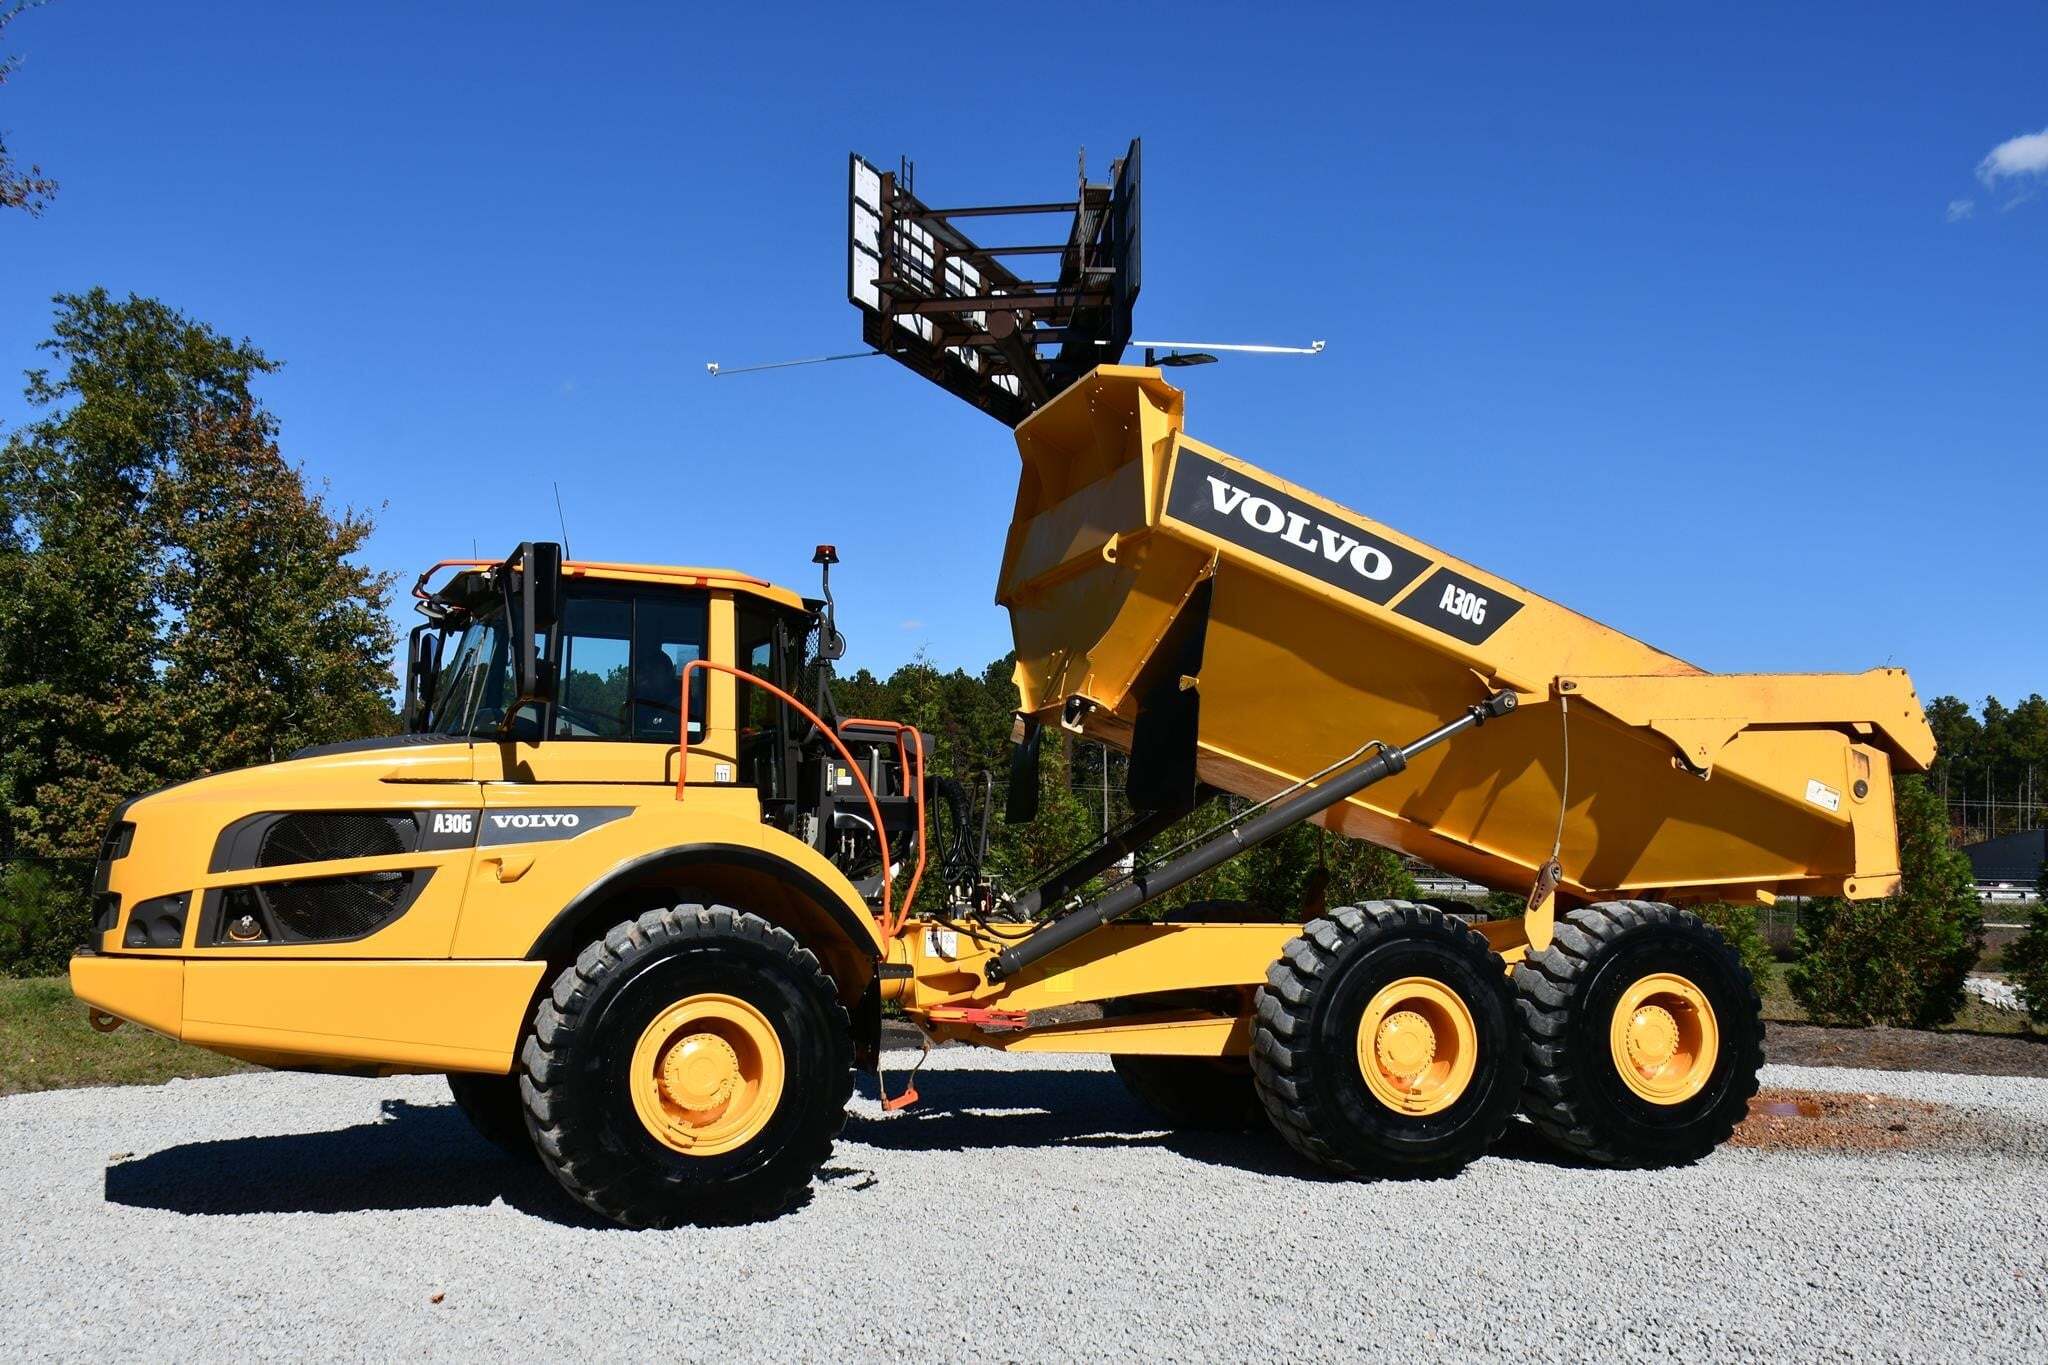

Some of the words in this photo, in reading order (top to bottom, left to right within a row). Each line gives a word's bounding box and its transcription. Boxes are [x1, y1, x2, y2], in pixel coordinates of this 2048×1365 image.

[1206, 475, 1393, 581] VOLVO
[1439, 583, 1488, 625] A30G
[433, 813, 473, 834] A30G
[491, 813, 580, 829] VOLVO
